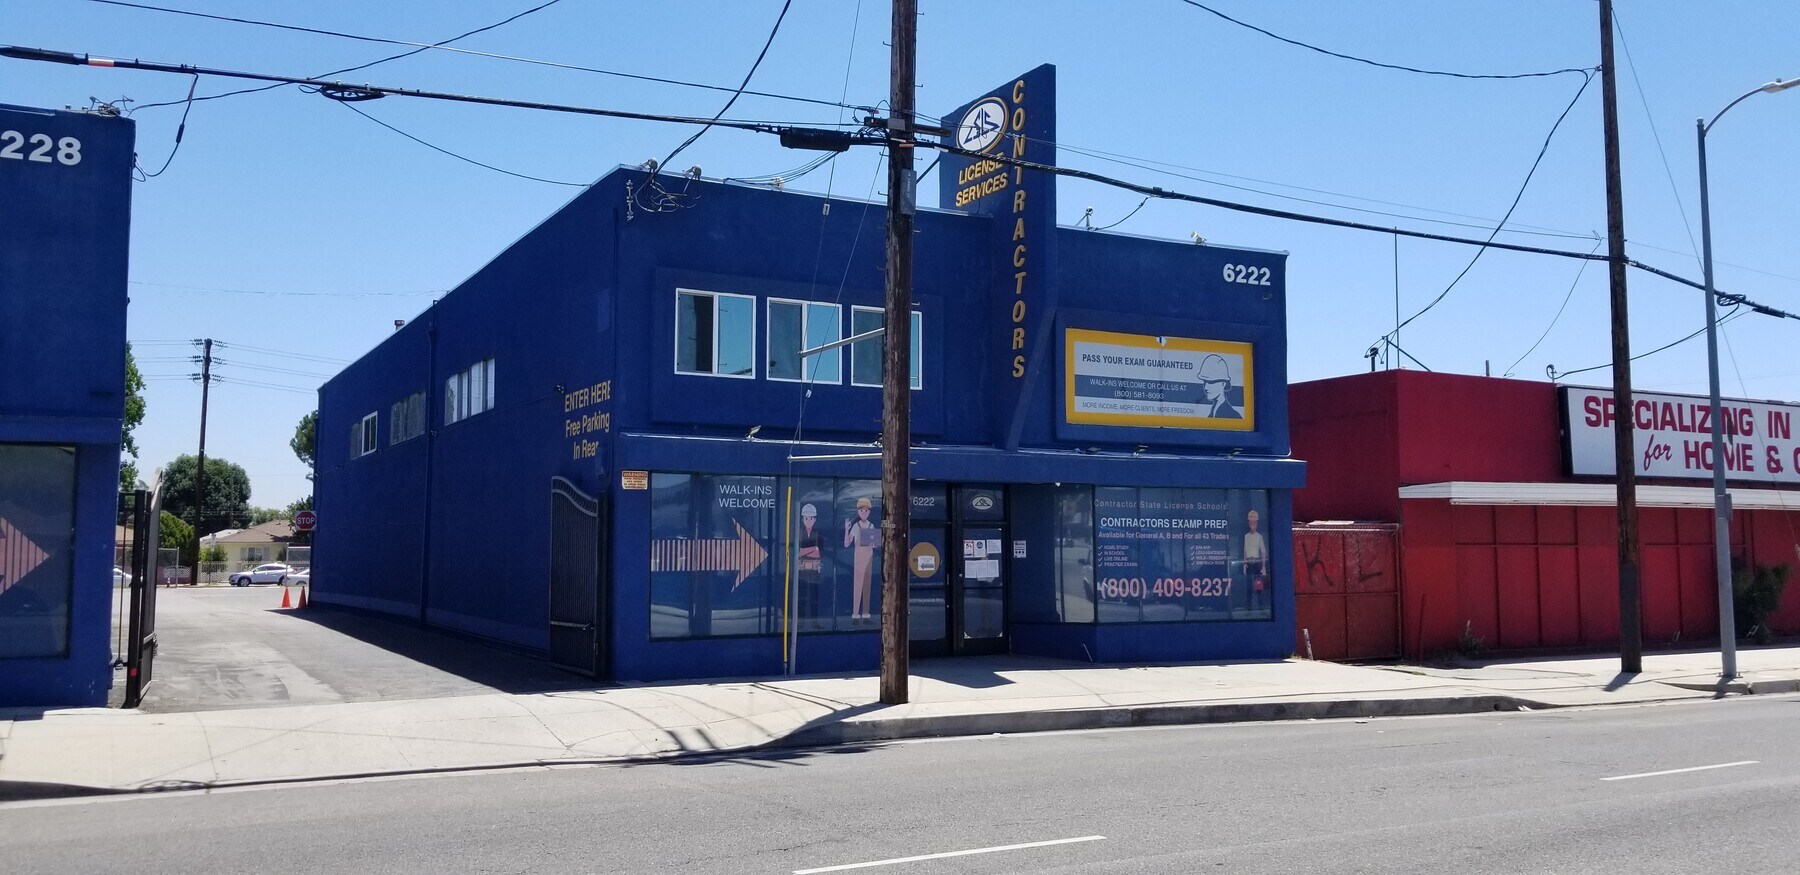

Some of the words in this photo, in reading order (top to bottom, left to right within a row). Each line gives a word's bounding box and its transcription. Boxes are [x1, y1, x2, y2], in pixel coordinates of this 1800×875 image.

[955, 172, 1008, 207] SERVICES
[1012, 79, 1027, 378] CONTRACTORS
[1222, 263, 1271, 286] 6222
[1082, 353, 1101, 363] PASS
[1103, 355, 1123, 365] YOUR
[1125, 356, 1145, 367] EXAM
[1147, 359, 1193, 370] GUARANTEED
[1090, 378, 1117, 387] WALK-INS
[1118, 380, 1146, 389] WELCOME
[565, 388, 589, 413] ENTER
[590, 379, 611, 405] HERE
[1114, 390, 1132, 398] (800)
[565, 419, 581, 438] Free
[581, 410, 610, 433] Parking
[1584, 395, 1753, 437] SPCIALIZNG
[1767, 410, 1791, 440] IN
[573, 441, 580, 460] In
[1643, 434, 1672, 471] for
[1683, 440, 1754, 472] HOME
[1766, 445, 1784, 474] &
[719, 484, 772, 495] WALK-INS
[718, 498, 776, 509] WELCOME
[912, 497, 935, 506] 6222
[1094, 500, 1137, 509] Contractor
[1140, 501, 1161, 509] State
[1164, 501, 1194, 510] License
[1100, 517, 1170, 528] CONTRACTORS
[1172, 519, 1202, 528] EXAMP
[1204, 519, 1228, 529] PREP
[1098, 531, 1126, 539] Available
[1101, 577, 1147, 600] (800)
[1153, 578, 1232, 598] 409-8237
